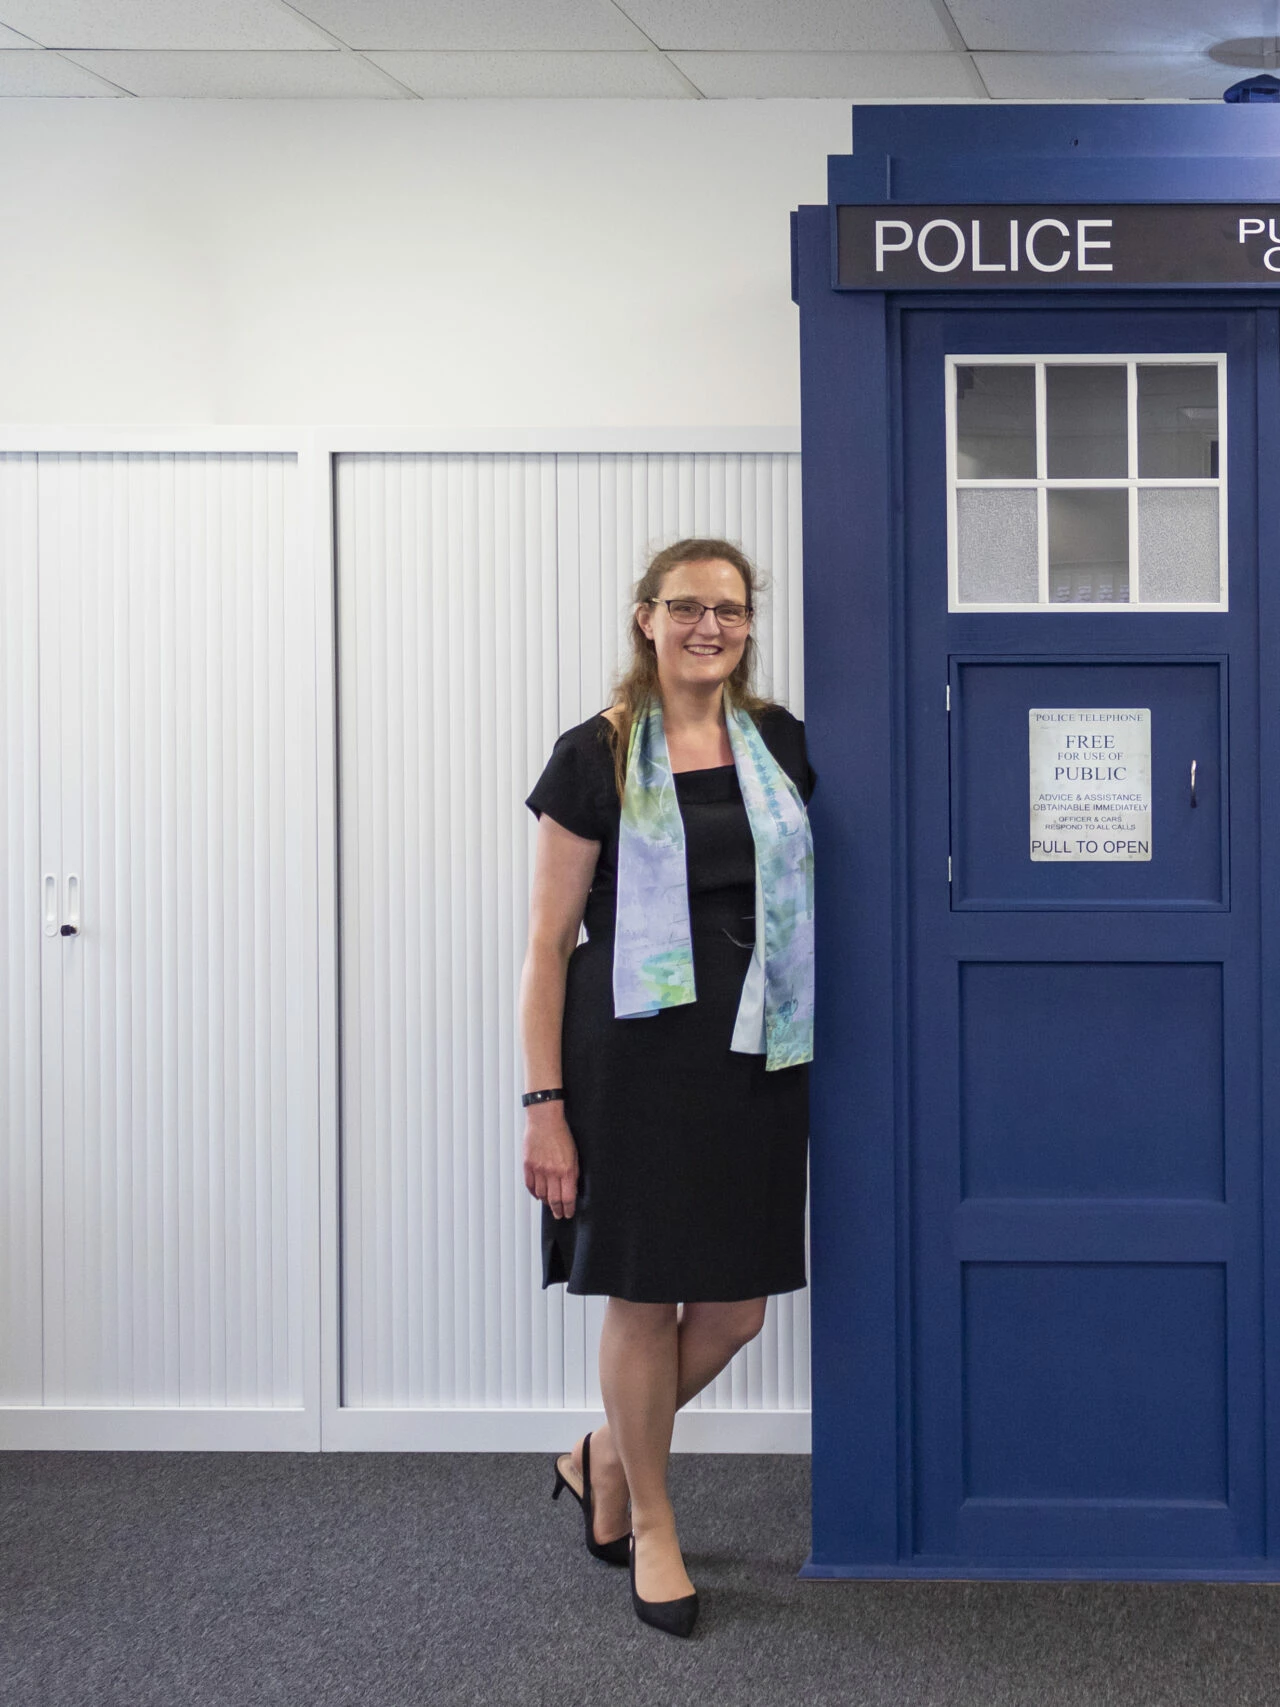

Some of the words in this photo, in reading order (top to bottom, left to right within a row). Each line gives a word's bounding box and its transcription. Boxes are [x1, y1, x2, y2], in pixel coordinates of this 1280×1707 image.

[875, 219, 1114, 273] POLICE
[1066, 735, 1115, 748] FREE
[1058, 752, 1080, 761] FOR
[1084, 752, 1105, 761] USE
[1109, 752, 1123, 761] OF
[1055, 767, 1126, 780] PUBLIC
[1032, 841, 1072, 853] PULL
[1076, 841, 1098, 853] TO
[1104, 841, 1149, 853] OPEN
